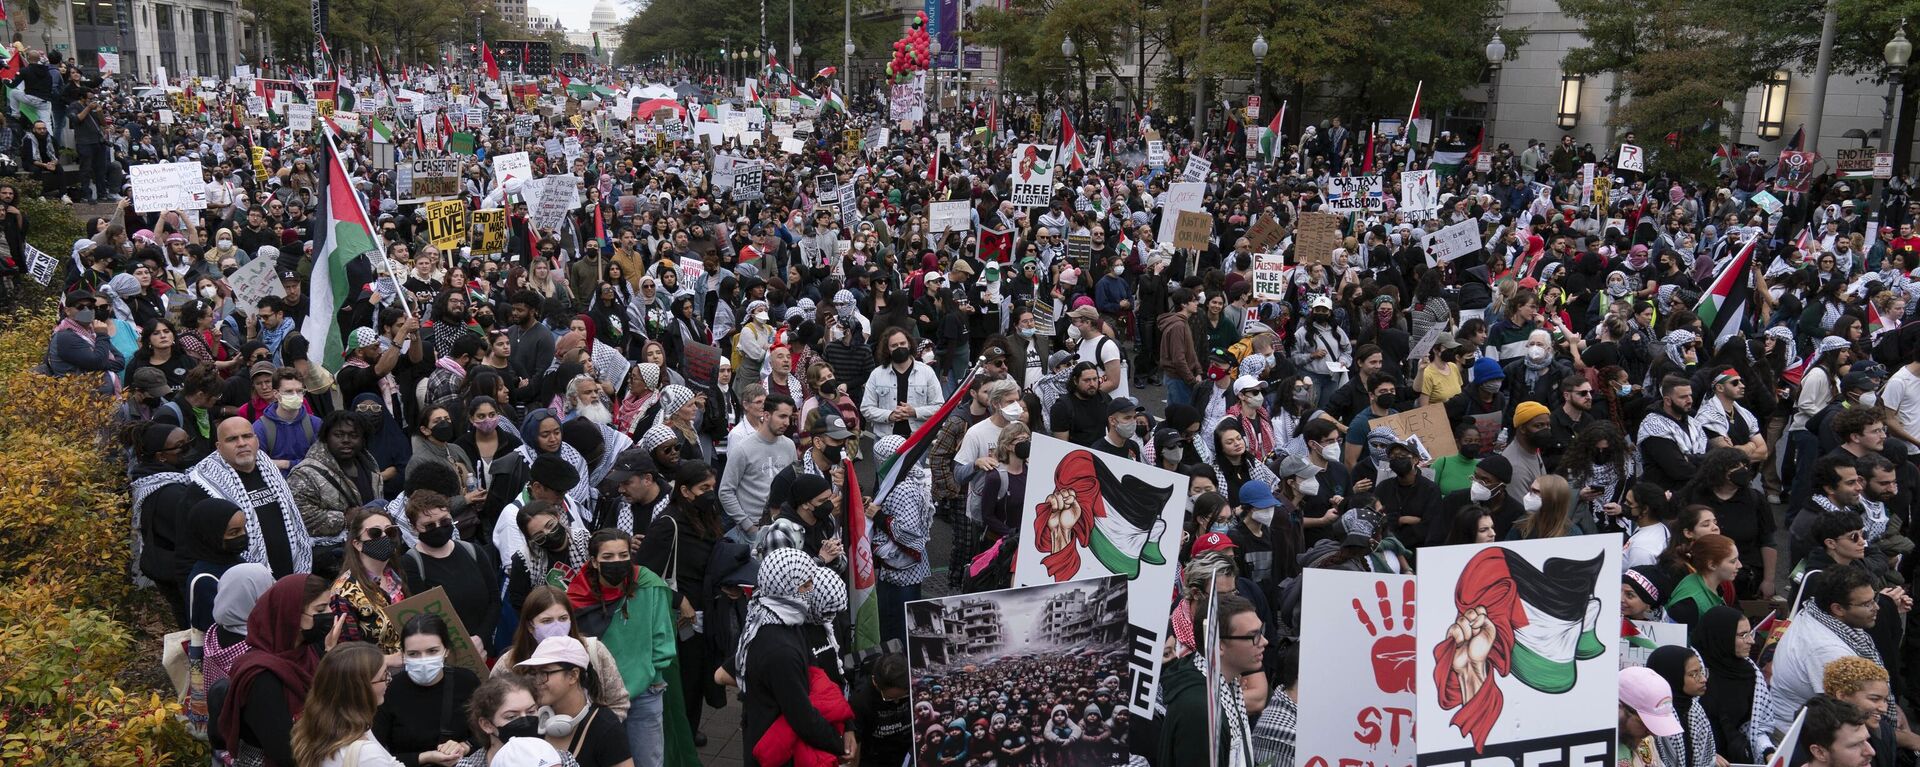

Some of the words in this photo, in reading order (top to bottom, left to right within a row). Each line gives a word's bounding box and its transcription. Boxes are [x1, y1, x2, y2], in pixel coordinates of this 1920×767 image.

[516, 119, 532, 128] FREE
[666, 122, 682, 133] FREE
[1837, 150, 1855, 159] END
[1858, 148, 1877, 159] THE
[414, 160, 457, 172] CEASEFIRE
[1836, 160, 1856, 168] WAR
[734, 171, 761, 188] FREE
[1189, 170, 1201, 178] FREE
[1334, 178, 1352, 186] OUR
[1356, 176, 1378, 186] TAX
[414, 180, 456, 196] PALESTINE
[1014, 184, 1050, 194] FREE
[1012, 194, 1050, 206] PALESTINE
[1331, 199, 1354, 208] THEIR
[1355, 198, 1380, 208] BLOOD
[428, 208, 442, 220] LET
[444, 202, 463, 216] GAZA
[474, 212, 490, 223] END
[493, 210, 505, 222] THE
[430, 212, 464, 240] LIVE!
[488, 222, 504, 232] WAR
[1182, 216, 1197, 228] NOT
[1198, 218, 1207, 228] IN
[494, 232, 504, 240] ON
[1178, 232, 1194, 242] OUR
[486, 240, 503, 251] GAZA
[1437, 248, 1452, 258] DIE
[1254, 254, 1284, 270] PALESTINE
[33, 262, 46, 281] NOT
[683, 266, 700, 278] NOW
[1256, 272, 1268, 280] WILL
[1269, 272, 1278, 281] BE
[1256, 282, 1280, 294] FREE
[1388, 412, 1432, 434] EVER
[1626, 569, 1660, 601] ESTINE
